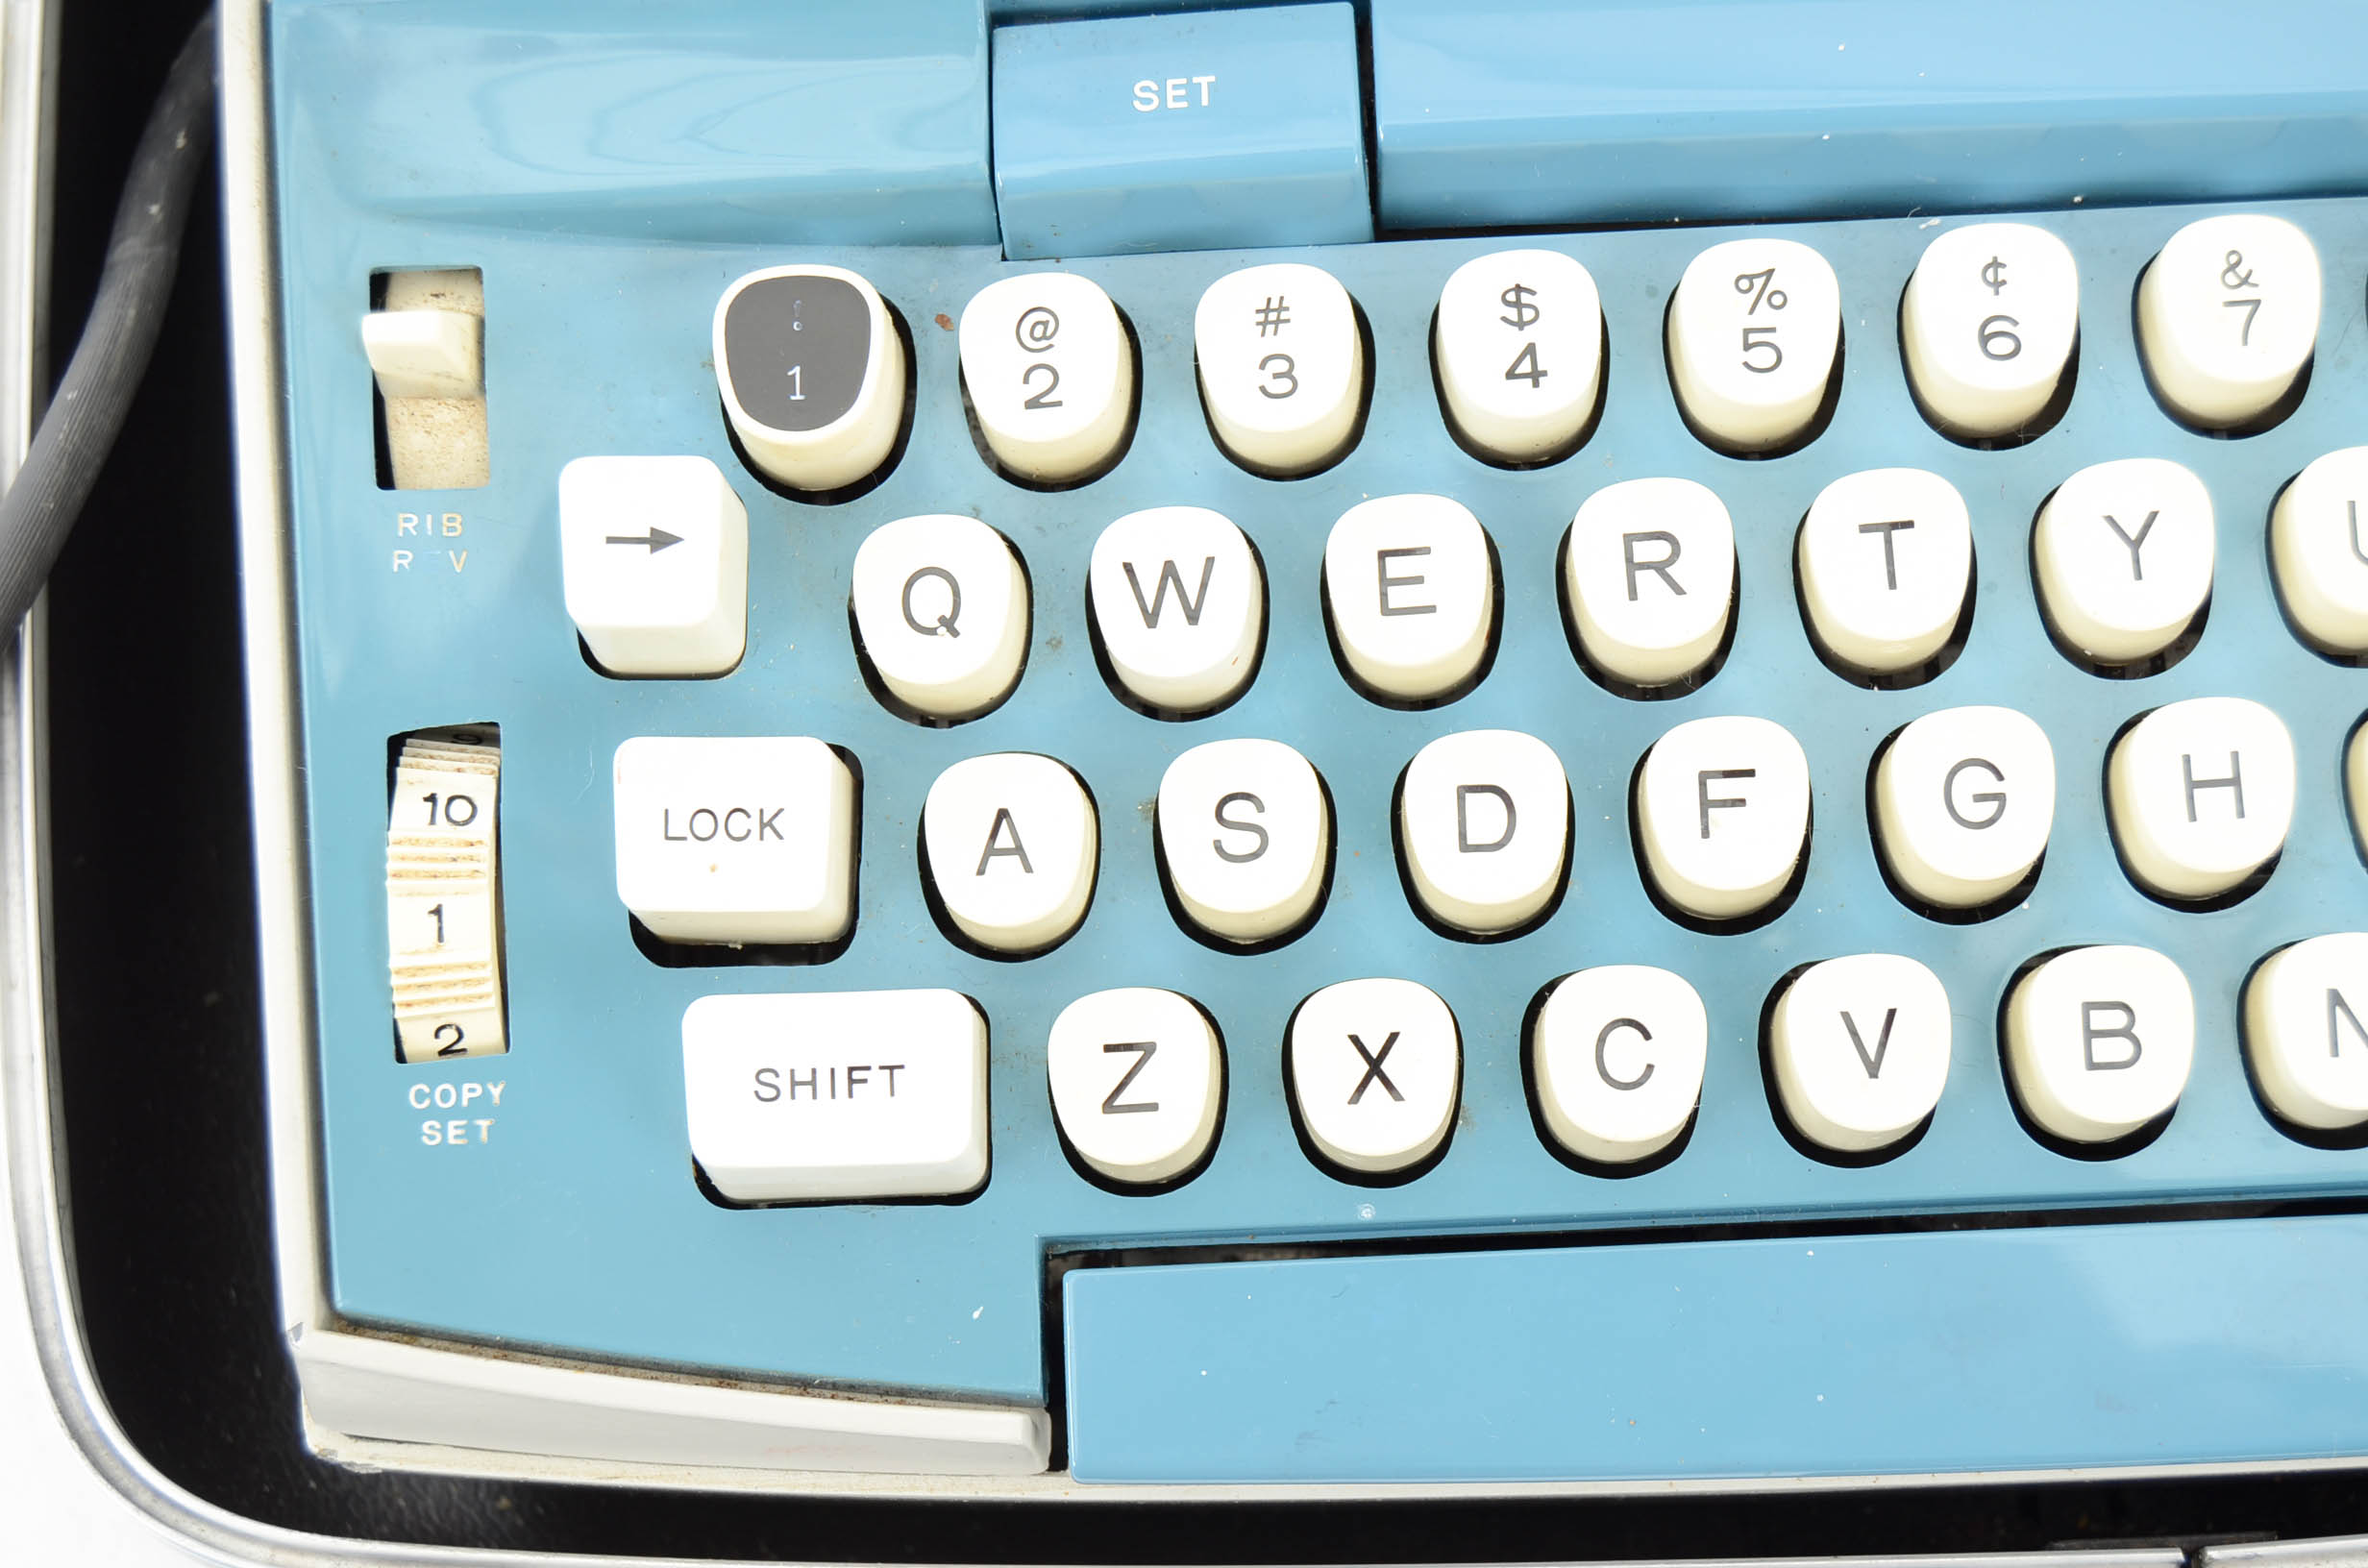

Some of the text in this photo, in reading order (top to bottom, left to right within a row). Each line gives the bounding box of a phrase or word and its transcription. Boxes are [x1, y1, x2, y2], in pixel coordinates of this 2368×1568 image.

[1132, 75, 1216, 112] SET
[1735, 268, 1788, 315] %
[1982, 257, 2007, 295] ¢
[2222, 250, 2258, 289] &
[1016, 306, 1059, 353] @
[1255, 296, 1291, 334] #
[1500, 283, 1540, 331] $
[2224, 299, 2261, 346] 7
[1742, 328, 1782, 373] 5
[1978, 315, 2021, 361] 6
[786, 364, 806, 401] 1
[1023, 363, 1063, 409] 2
[1259, 354, 1297, 399] 3
[1505, 342, 1547, 388] 4
[397, 512, 464, 537] RIB
[2104, 511, 2159, 580] Y
[393, 549, 468, 574] RV
[1623, 531, 1687, 600] R
[1859, 520, 1914, 590] T
[902, 567, 961, 638] Q
[1122, 556, 1215, 628] W
[1377, 547, 1437, 616] E
[423, 793, 478, 826] 10
[1698, 769, 1756, 839] F
[1944, 758, 2007, 829] G
[2183, 751, 2245, 821] H
[664, 808, 784, 842] LOCK
[976, 808, 1033, 875] A
[1213, 792, 1269, 863] S
[1457, 784, 1517, 853] D
[427, 903, 446, 943] 1
[433, 1023, 469, 1057] 2
[1595, 1017, 1655, 1090] C
[1840, 1008, 1897, 1079] V
[2082, 1001, 2142, 1070] B
[754, 1065, 904, 1102] SHIFT
[1102, 1041, 1159, 1115] Z
[1347, 1032, 1405, 1105] X
[408, 1080, 506, 1110] COPY
[421, 1118, 496, 1146] SET
